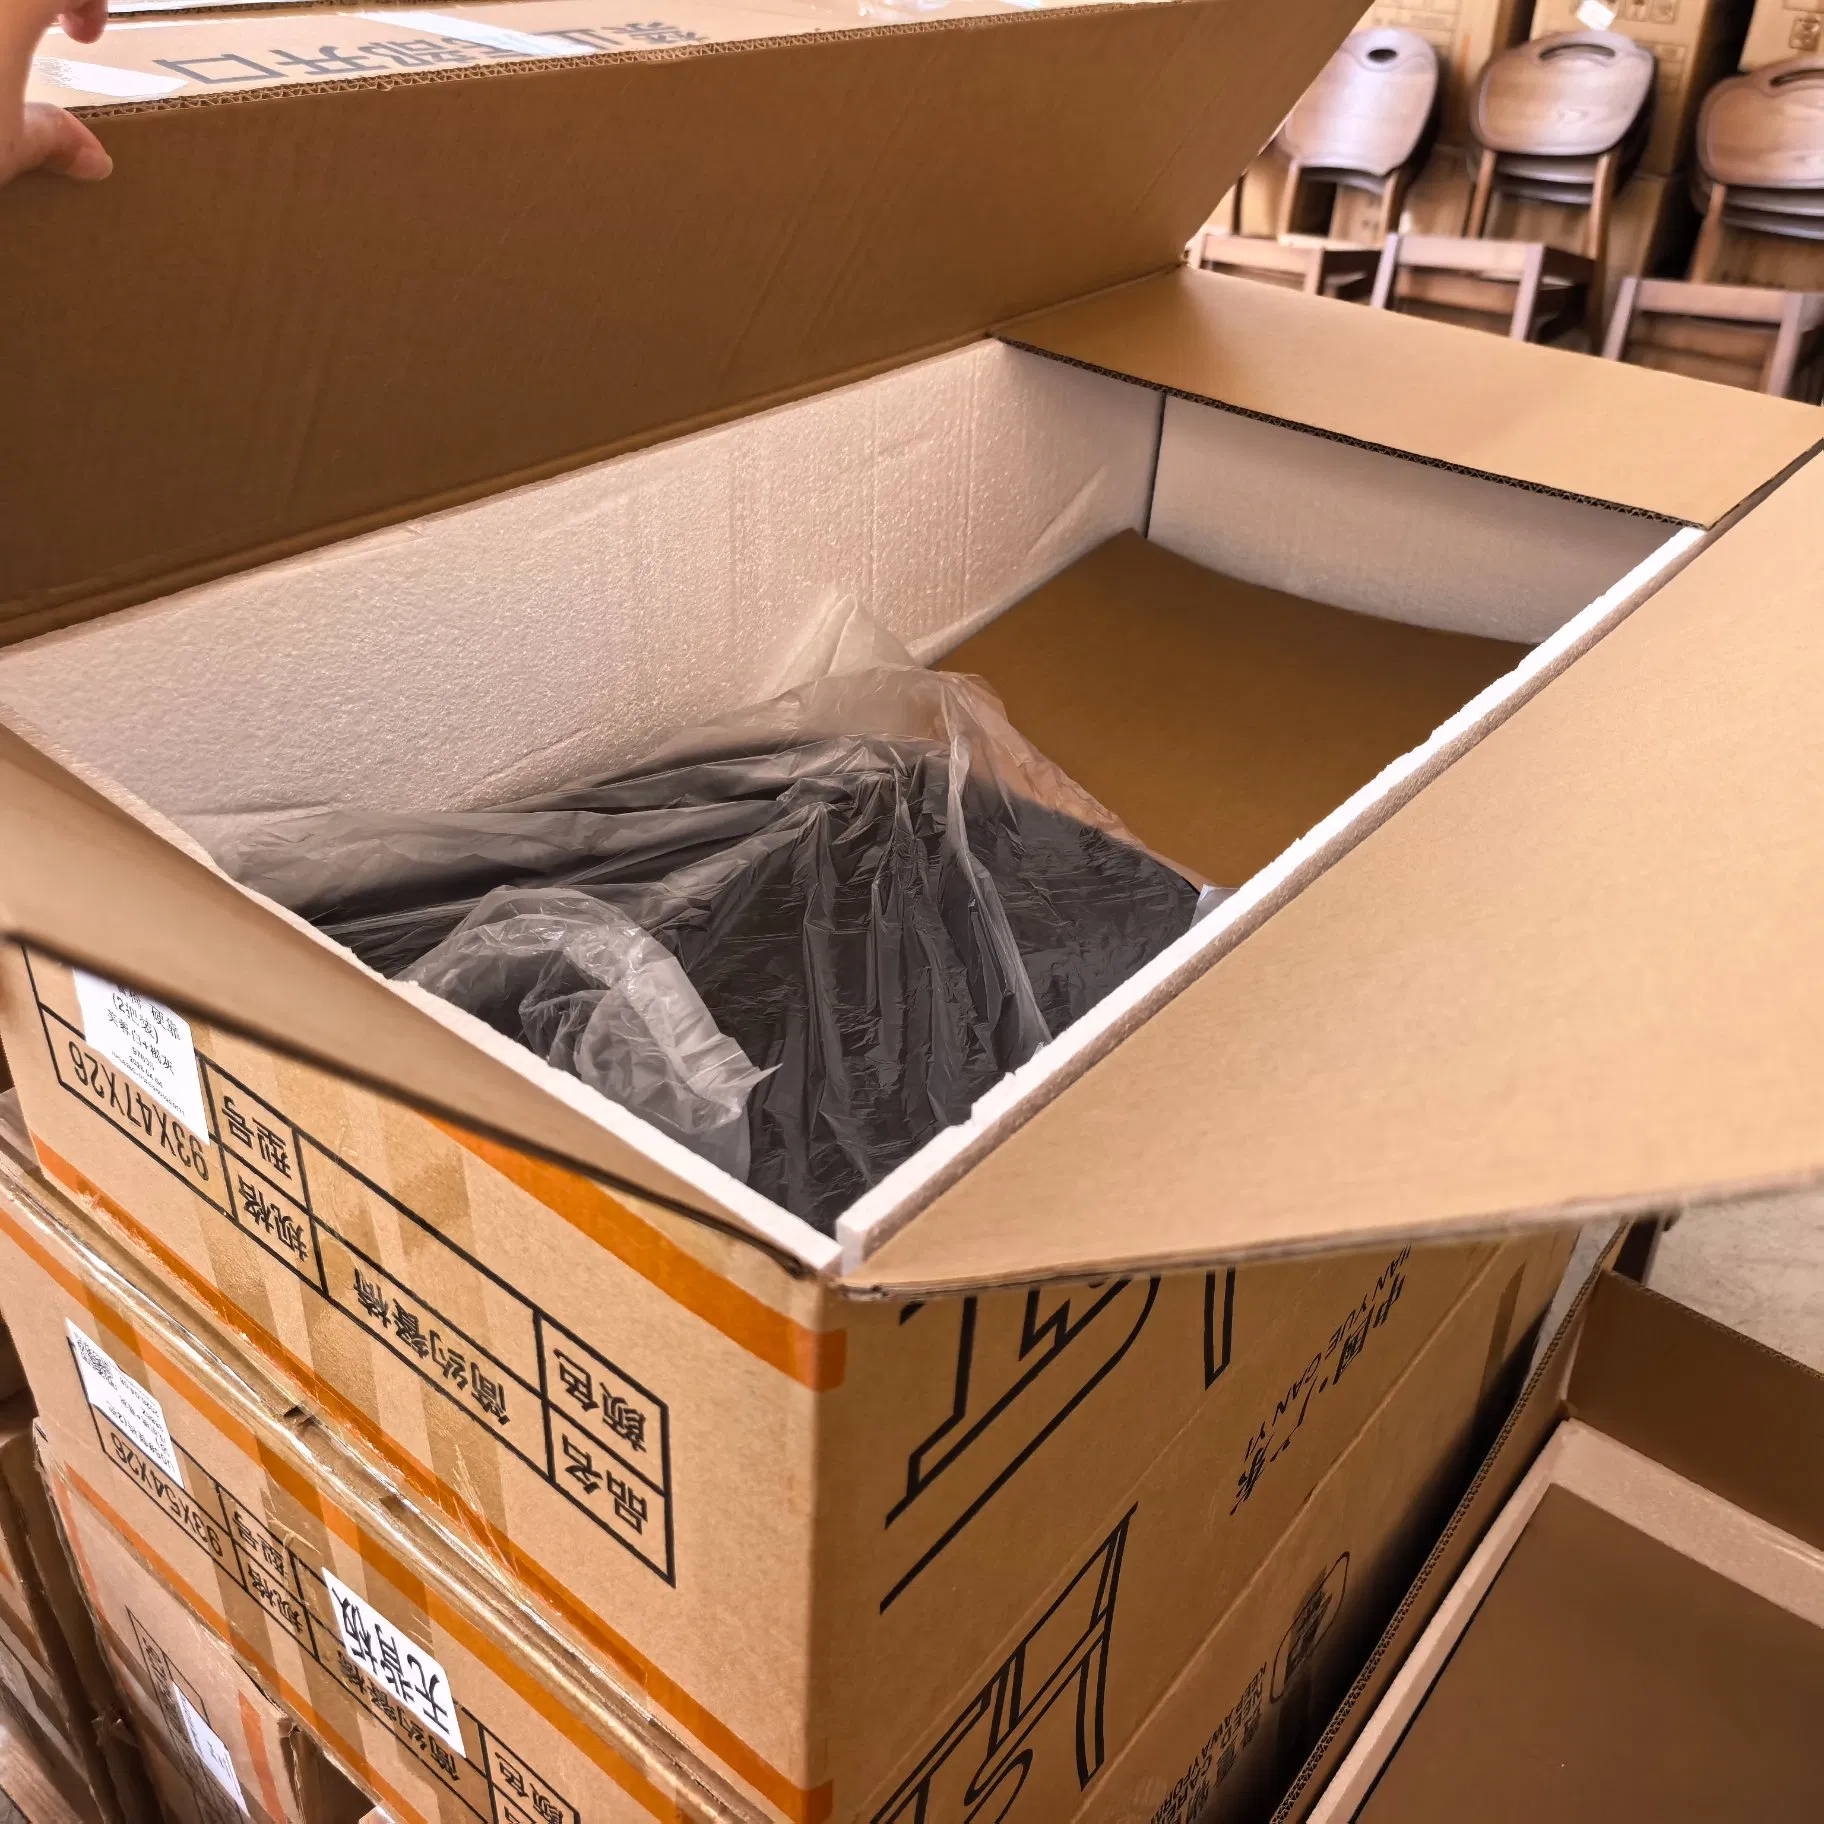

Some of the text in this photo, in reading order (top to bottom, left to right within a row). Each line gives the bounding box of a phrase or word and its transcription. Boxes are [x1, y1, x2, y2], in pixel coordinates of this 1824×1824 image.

[68, 1041, 209, 1181] 93X47X26
[221, 1096, 293, 1180] 型号
[237, 1173, 309, 1262] 规格
[353, 1267, 510, 1425] 简约餐椅
[553, 1348, 647, 1453] 颜色
[110, 1432, 224, 1557] 93X54X26
[562, 1433, 649, 1535] 品名
[232, 1510, 288, 1577] 型号
[248, 1563, 303, 1633] 规格
[331, 1587, 451, 1736] 无背板
[338, 1650, 460, 1782] 简约餐椅
